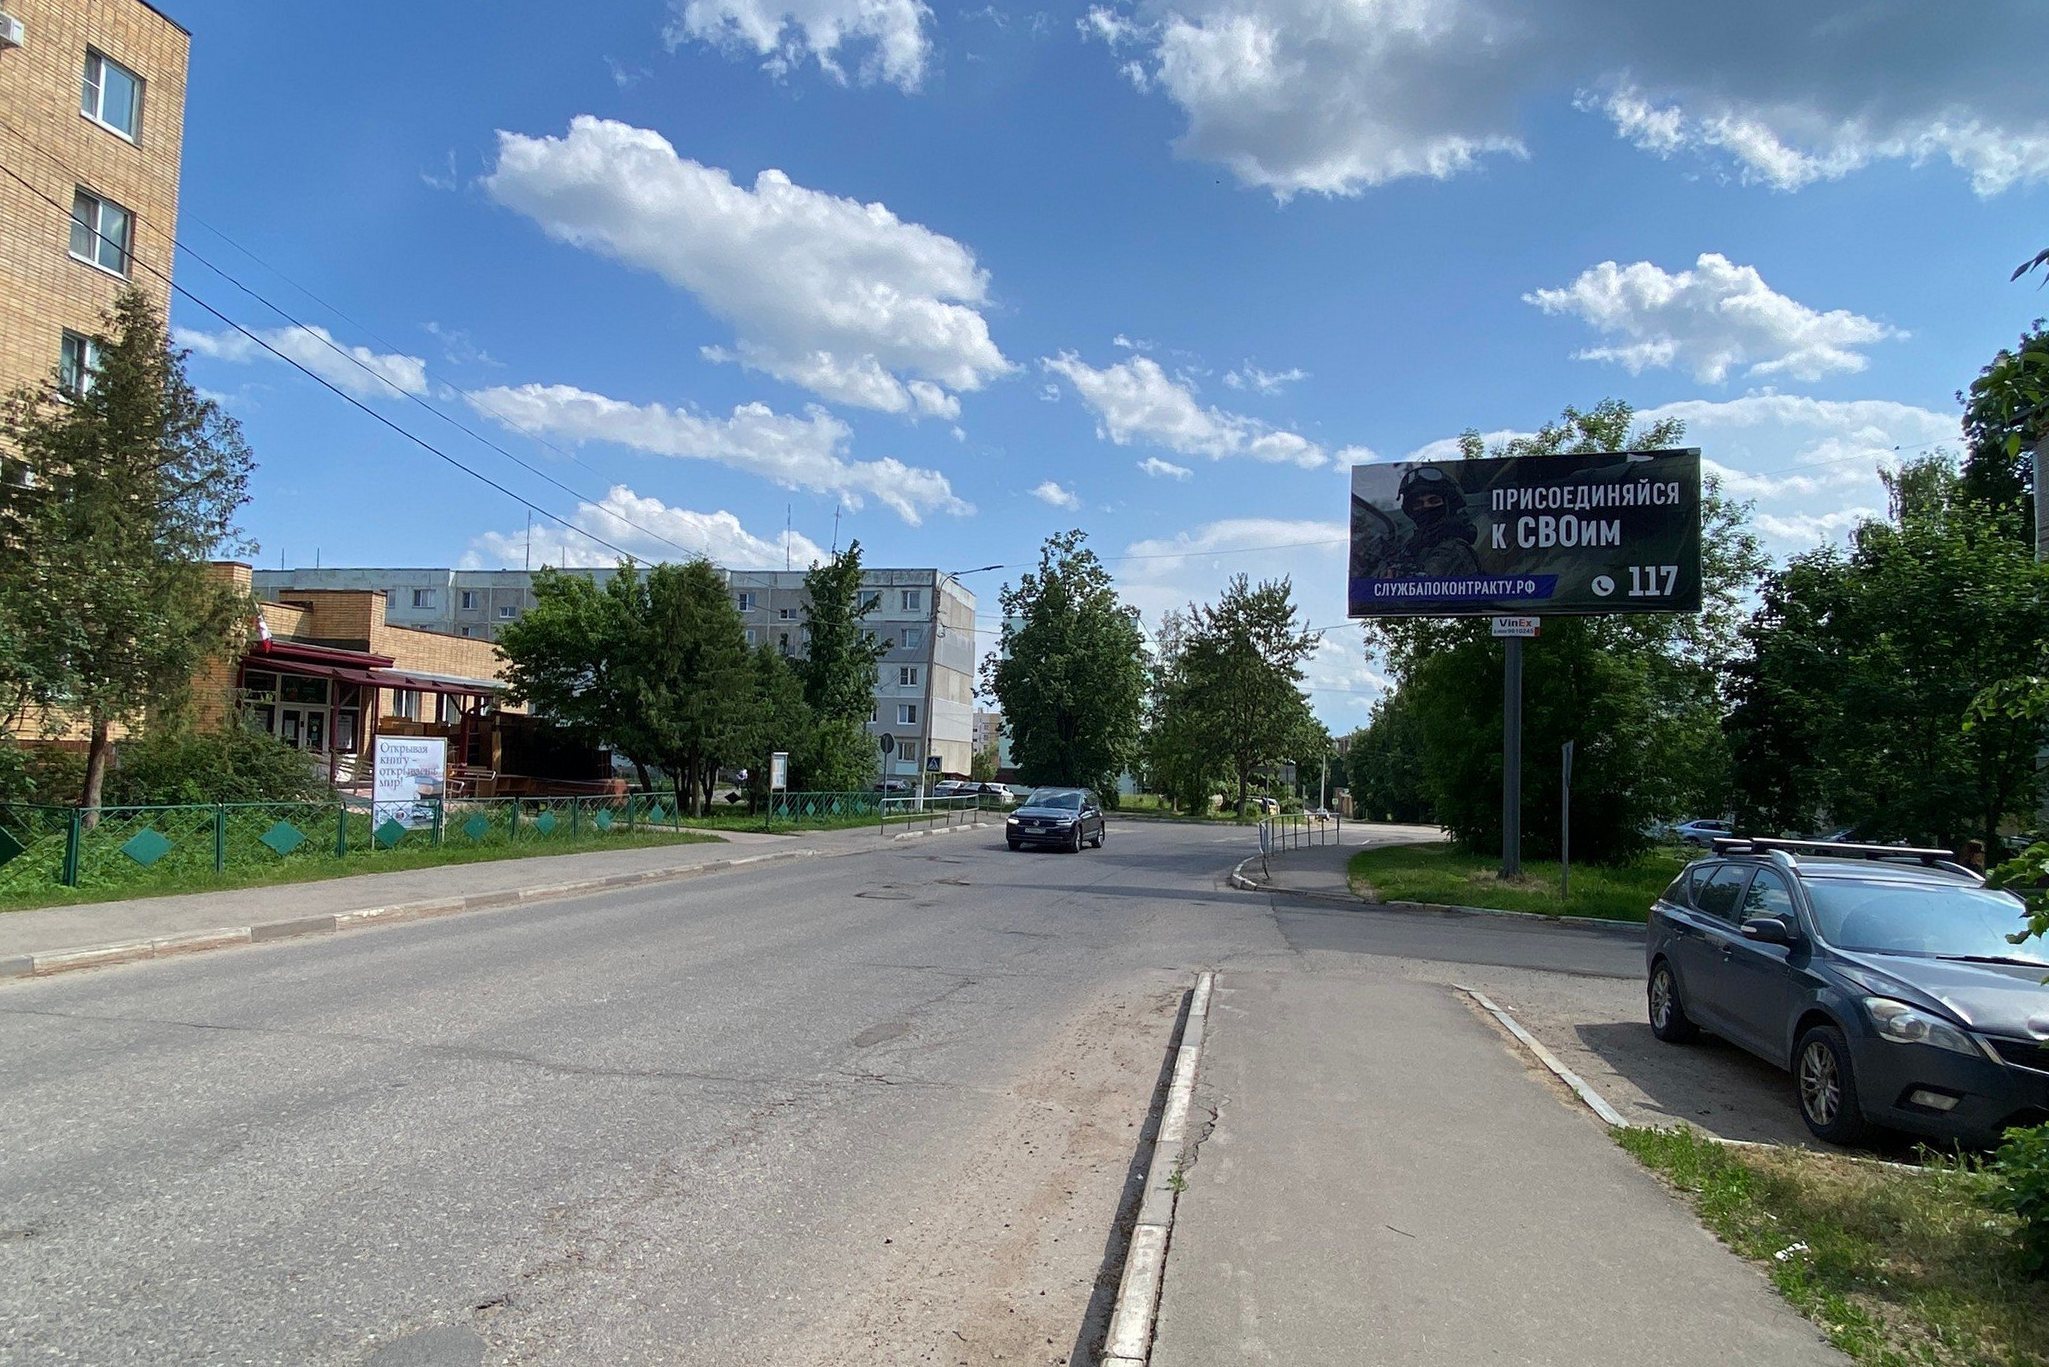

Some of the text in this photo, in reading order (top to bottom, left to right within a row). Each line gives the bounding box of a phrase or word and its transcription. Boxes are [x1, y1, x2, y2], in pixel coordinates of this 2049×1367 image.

[1492, 478, 1680, 511] ПРИСОЕДИНЯЙСЯ
[1628, 565, 1679, 597] 117
[1374, 580, 1536, 597] СЛУЖБАПОКОНТРАКТУ.РФ
[1499, 618, 1532, 627] VinEx
[380, 742, 428, 756] Открывая
[379, 756, 410, 769] книгу
[379, 776, 404, 790] мир!
